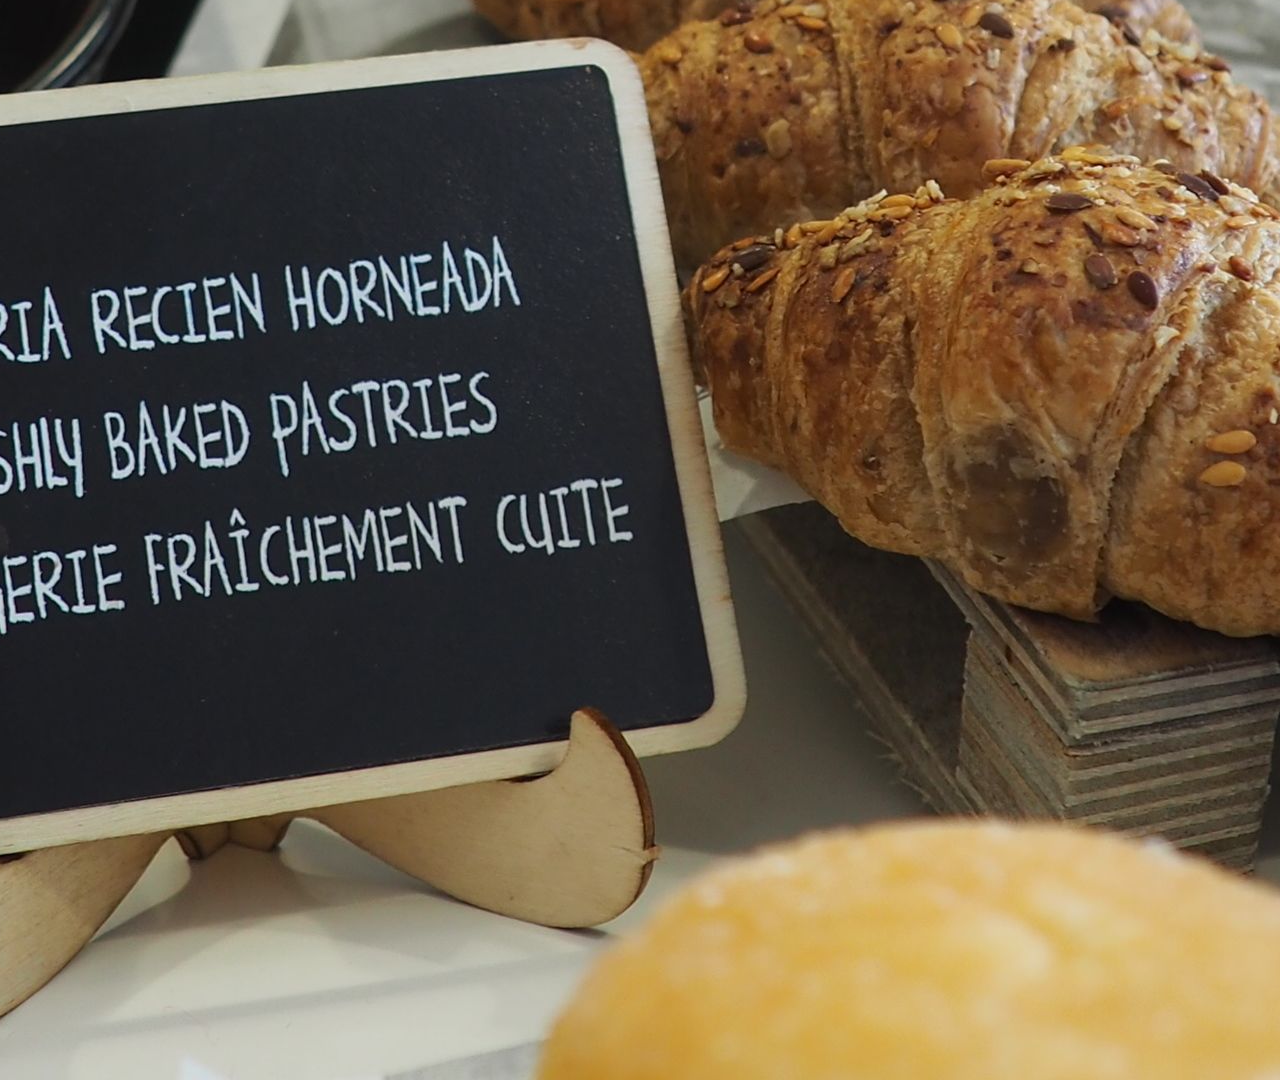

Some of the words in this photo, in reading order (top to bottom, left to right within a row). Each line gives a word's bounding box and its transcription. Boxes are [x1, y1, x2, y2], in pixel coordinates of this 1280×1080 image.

[91, 272, 267, 355] RECIEN
[285, 235, 521, 331] HORNEADA
[103, 399, 251, 480] BAKED
[269, 371, 498, 477] PASTRIES
[144, 495, 467, 605] FRAÎCHEMENT
[496, 478, 633, 555] CUITE
